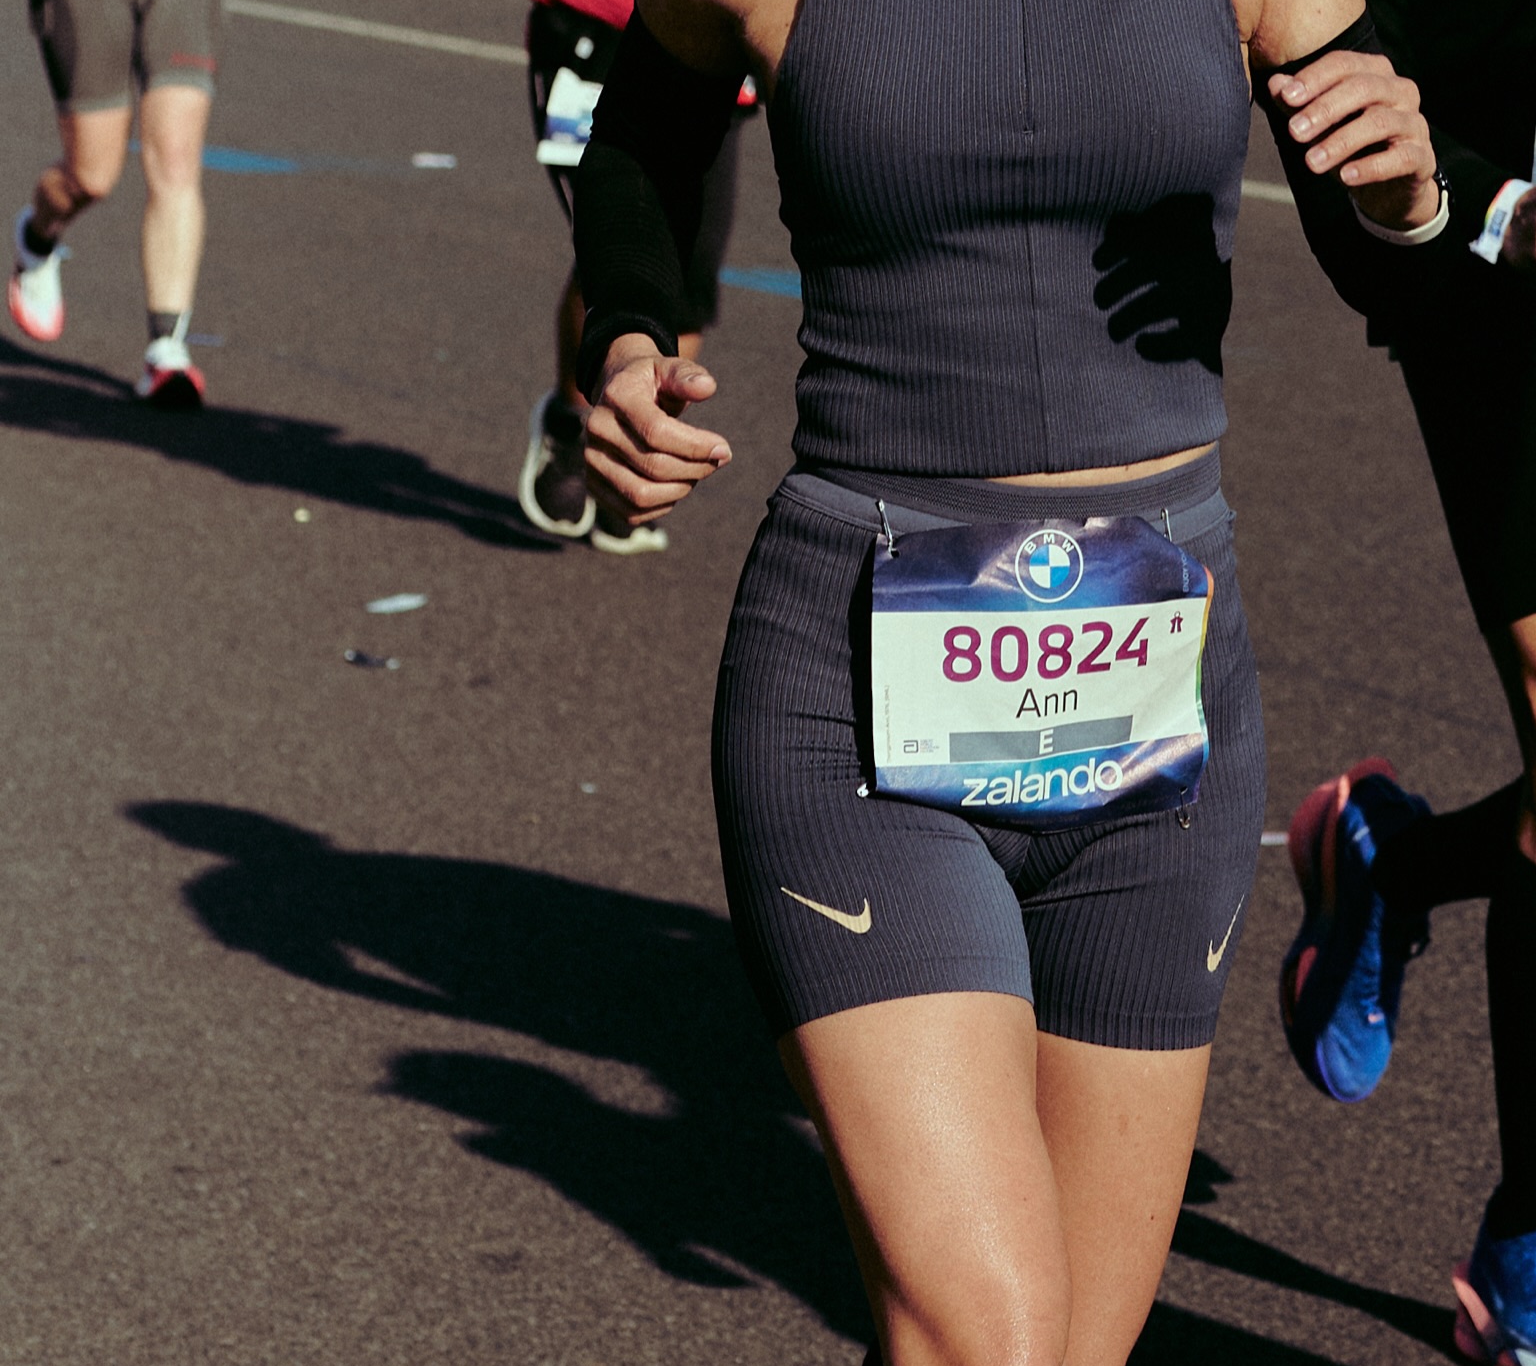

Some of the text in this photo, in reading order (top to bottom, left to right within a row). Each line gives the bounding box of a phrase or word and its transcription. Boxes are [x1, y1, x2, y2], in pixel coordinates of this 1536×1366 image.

[1024, 533, 1075, 555] BMW
[942, 616, 1151, 683] 80824
[1016, 688, 1079, 719] Ann
[1038, 728, 1055, 755] E
[960, 758, 1124, 807] zalando
